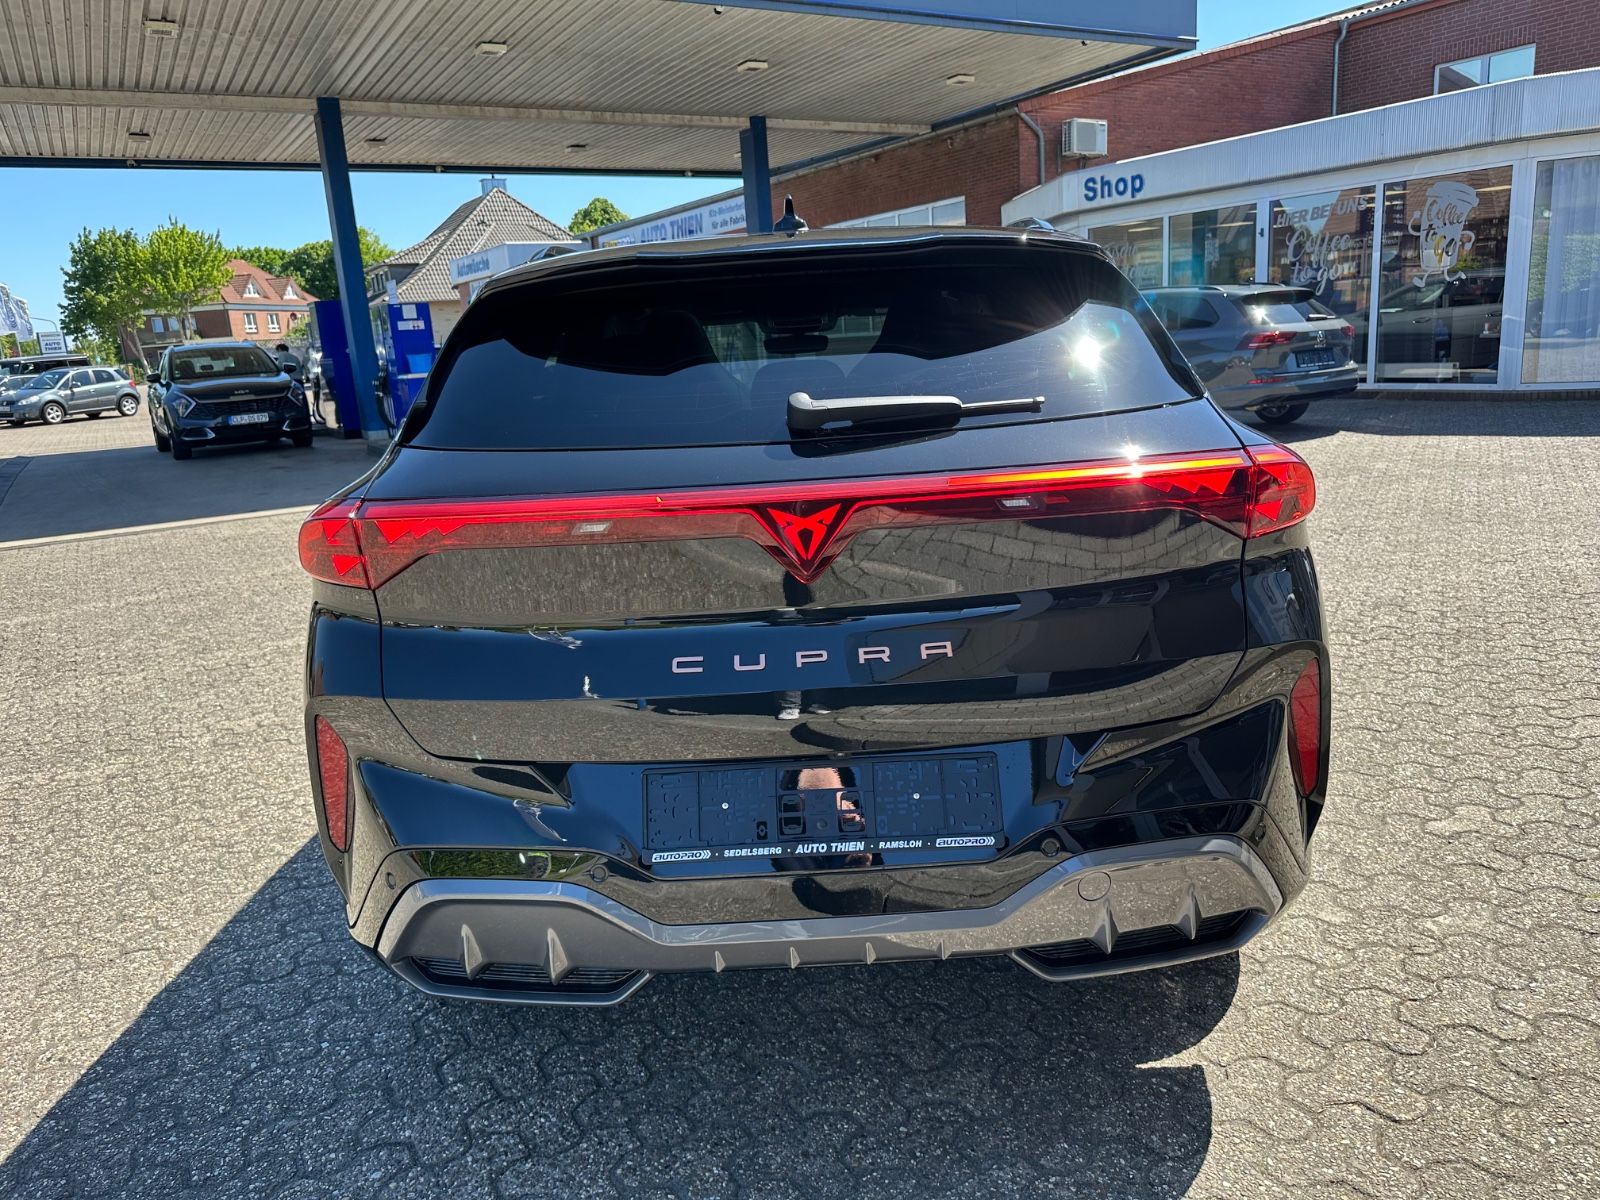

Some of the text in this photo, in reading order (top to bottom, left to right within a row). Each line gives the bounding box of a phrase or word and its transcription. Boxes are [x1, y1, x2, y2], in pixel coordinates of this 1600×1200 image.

[1084, 174, 1144, 202] Shop
[1276, 208, 1309, 227] HIER
[1336, 195, 1369, 215] UNS
[640, 221, 668, 243] AUTO
[669, 213, 703, 240] THIEN
[1285, 228, 1351, 268] Coffee
[671, 641, 953, 674] CUPRA
[723, 846, 782, 857] SEDELSBERG
[795, 842, 828, 854] AUTO
[830, 841, 865, 852] THIEN
[879, 840, 923, 849] RAMSLOH
